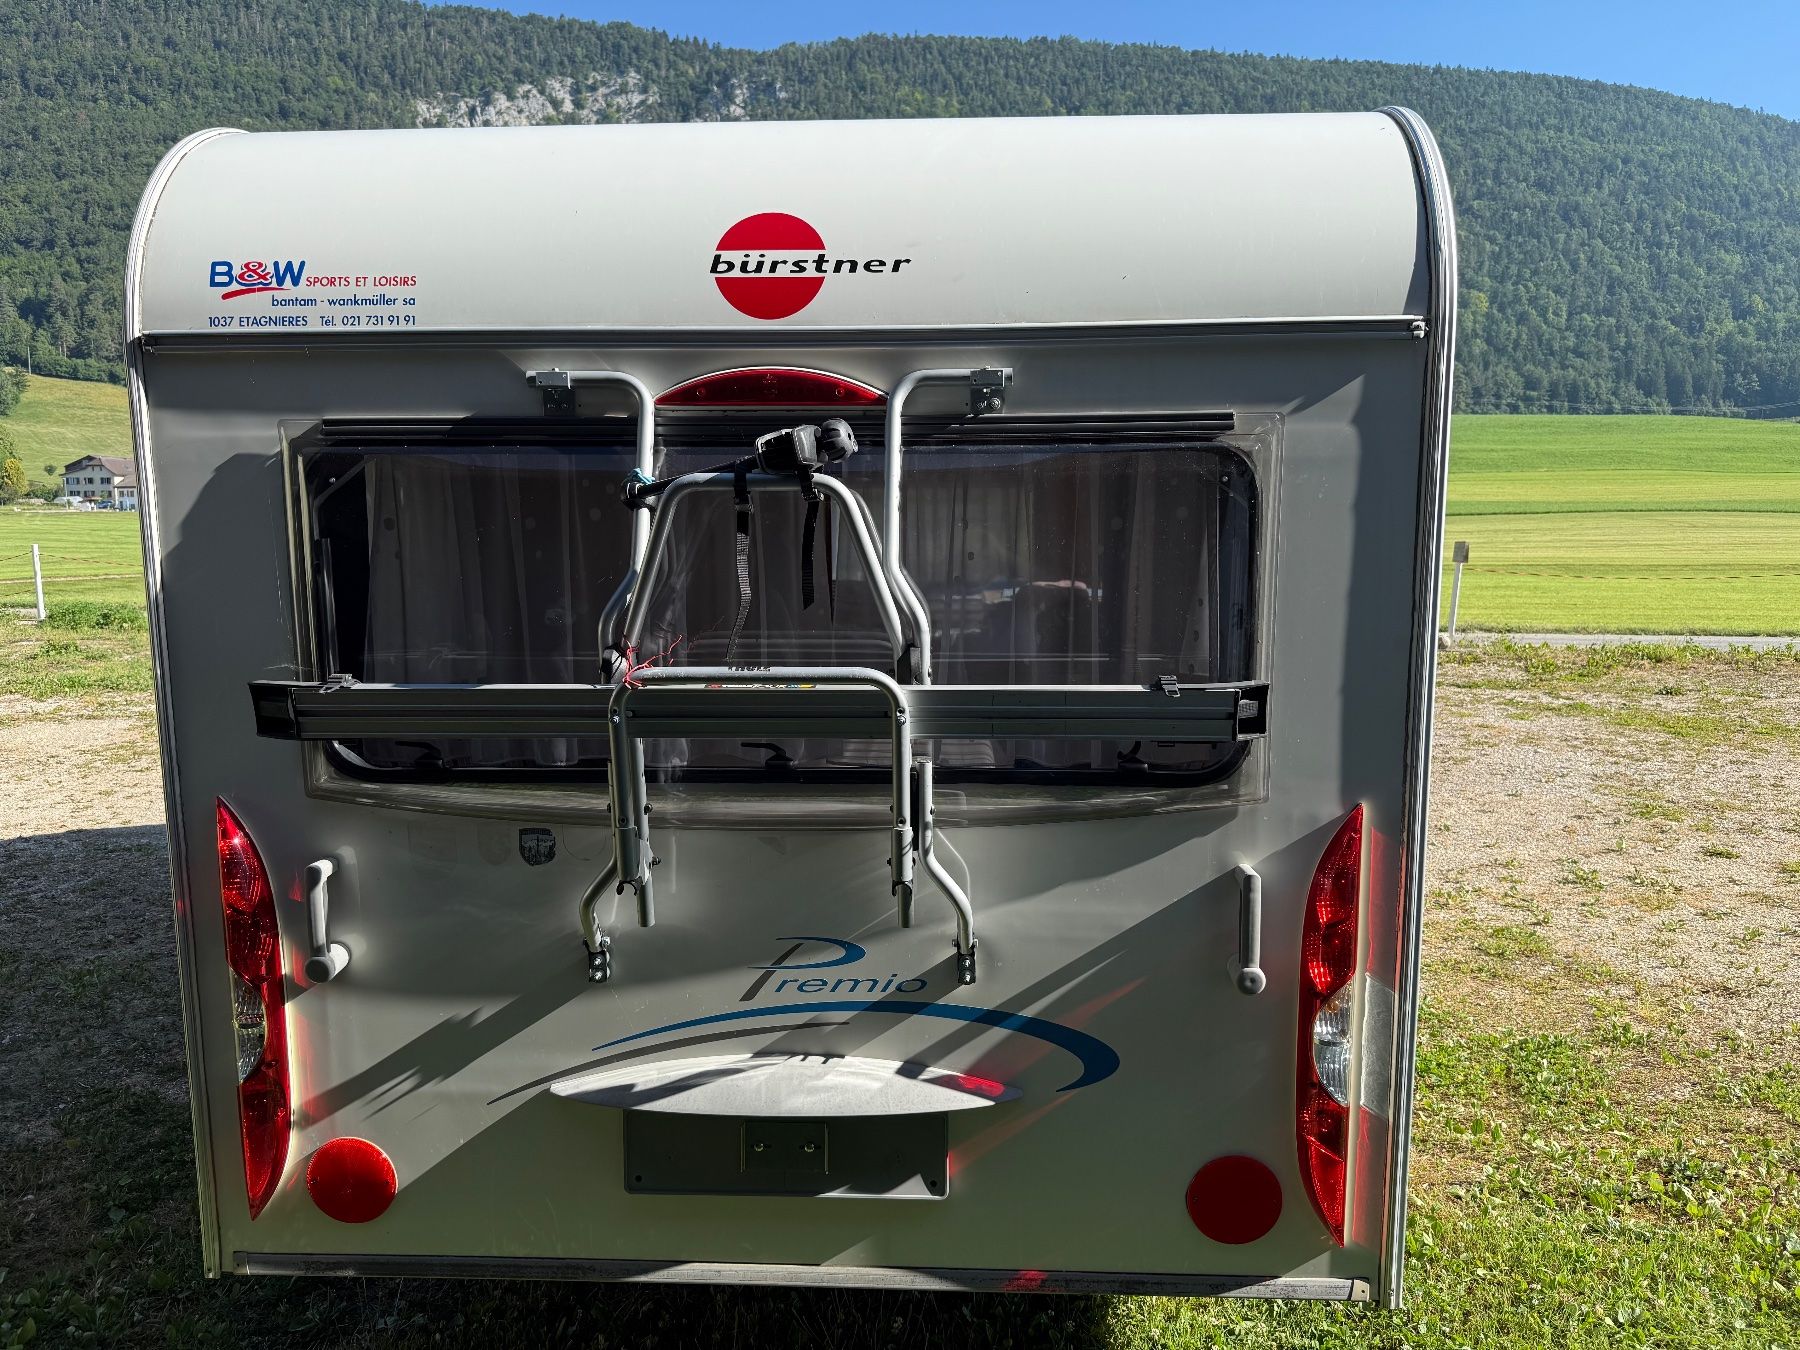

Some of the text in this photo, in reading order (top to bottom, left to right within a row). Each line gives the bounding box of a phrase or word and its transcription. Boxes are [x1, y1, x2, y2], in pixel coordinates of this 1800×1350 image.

[209, 260, 417, 287] B&W SPORTS ET LOISIRS
[709, 253, 912, 274] bürstner
[271, 294, 317, 307] bantam
[327, 293, 399, 307] wankmüller
[402, 297, 416, 306] sa
[208, 315, 416, 327] 1037 ETAGNIERES Tél. 021 731 91 91
[739, 936, 928, 1002] Premio
